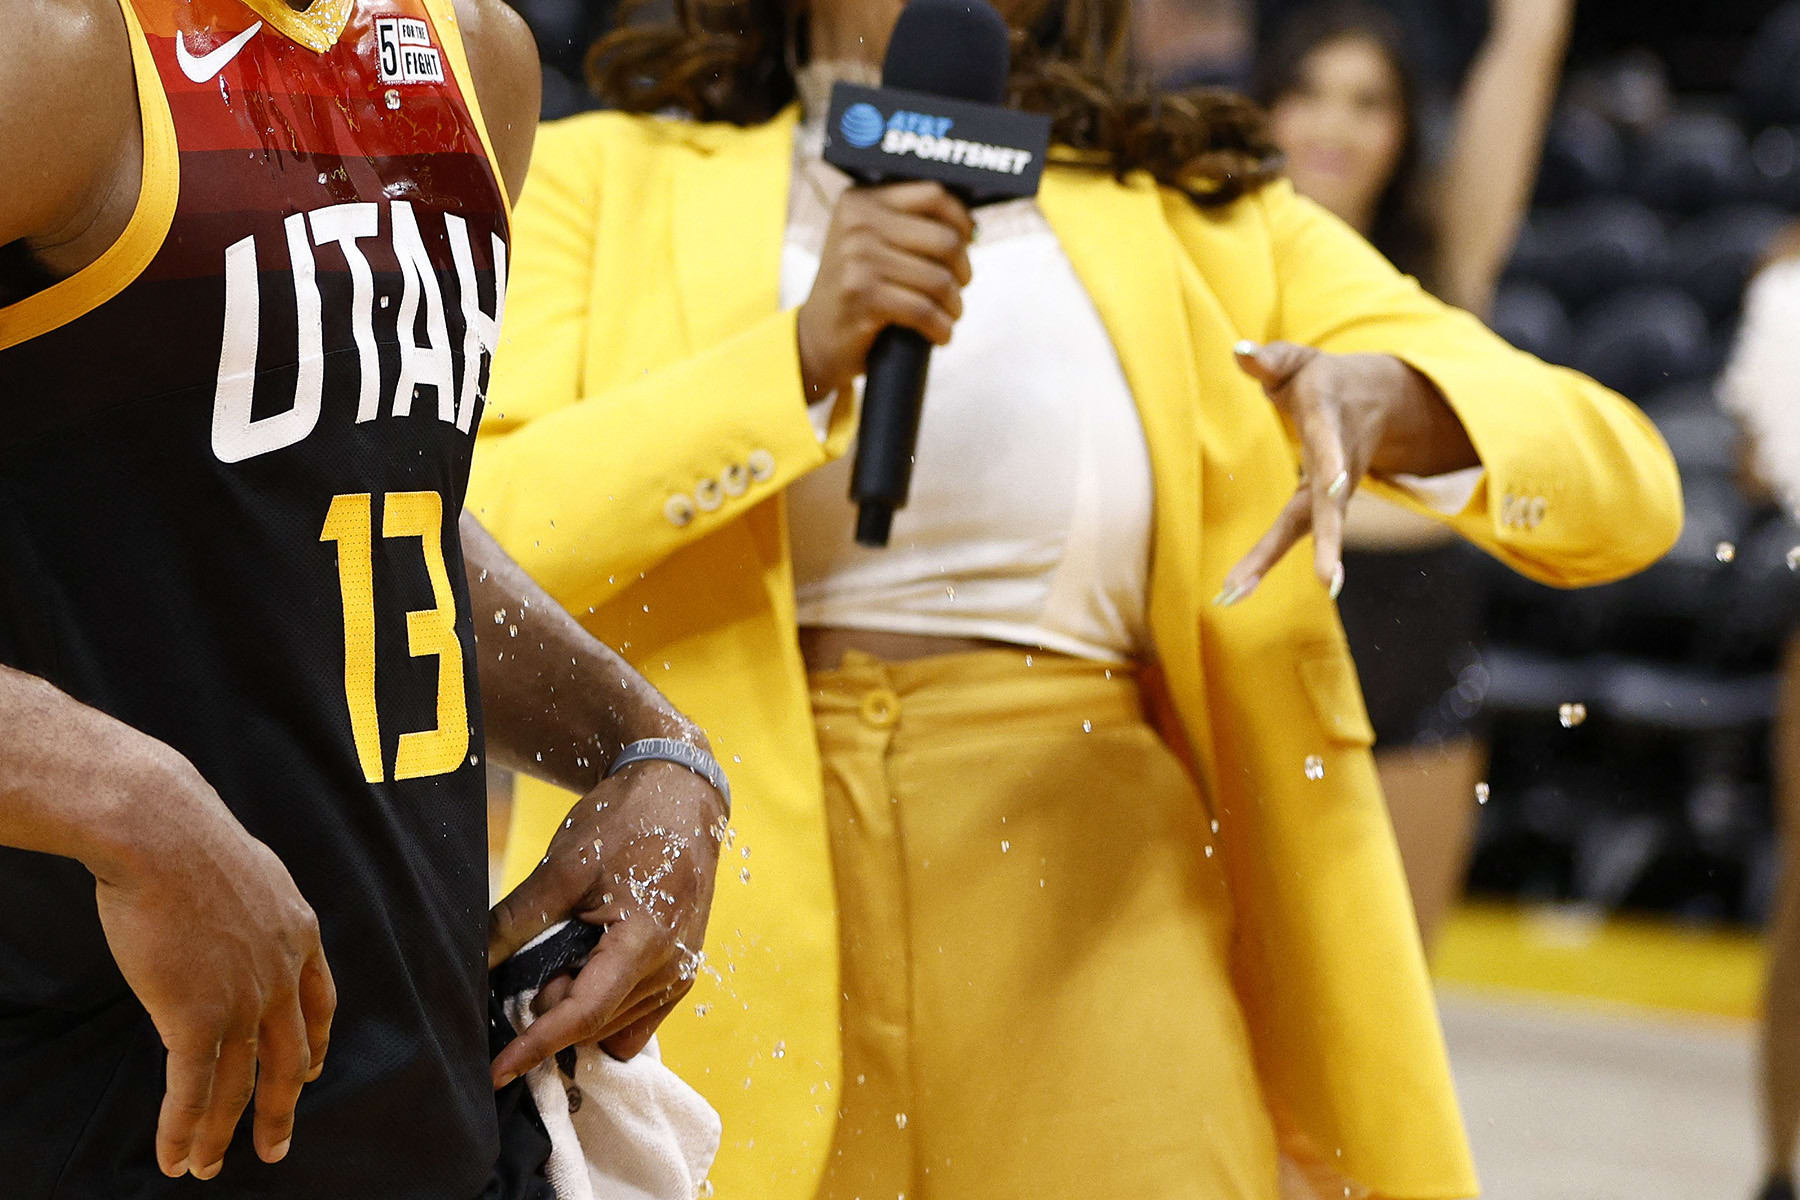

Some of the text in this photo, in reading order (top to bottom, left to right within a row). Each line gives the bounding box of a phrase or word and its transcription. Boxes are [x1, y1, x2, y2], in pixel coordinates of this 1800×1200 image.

[380, 24, 397, 76] 5
[402, 24, 426, 40] FOR THE
[405, 52, 438, 75] FIGHT
[881, 128, 1032, 175] SPORTSNET
[211, 200, 507, 464] UTAH
[319, 491, 469, 783] 13
